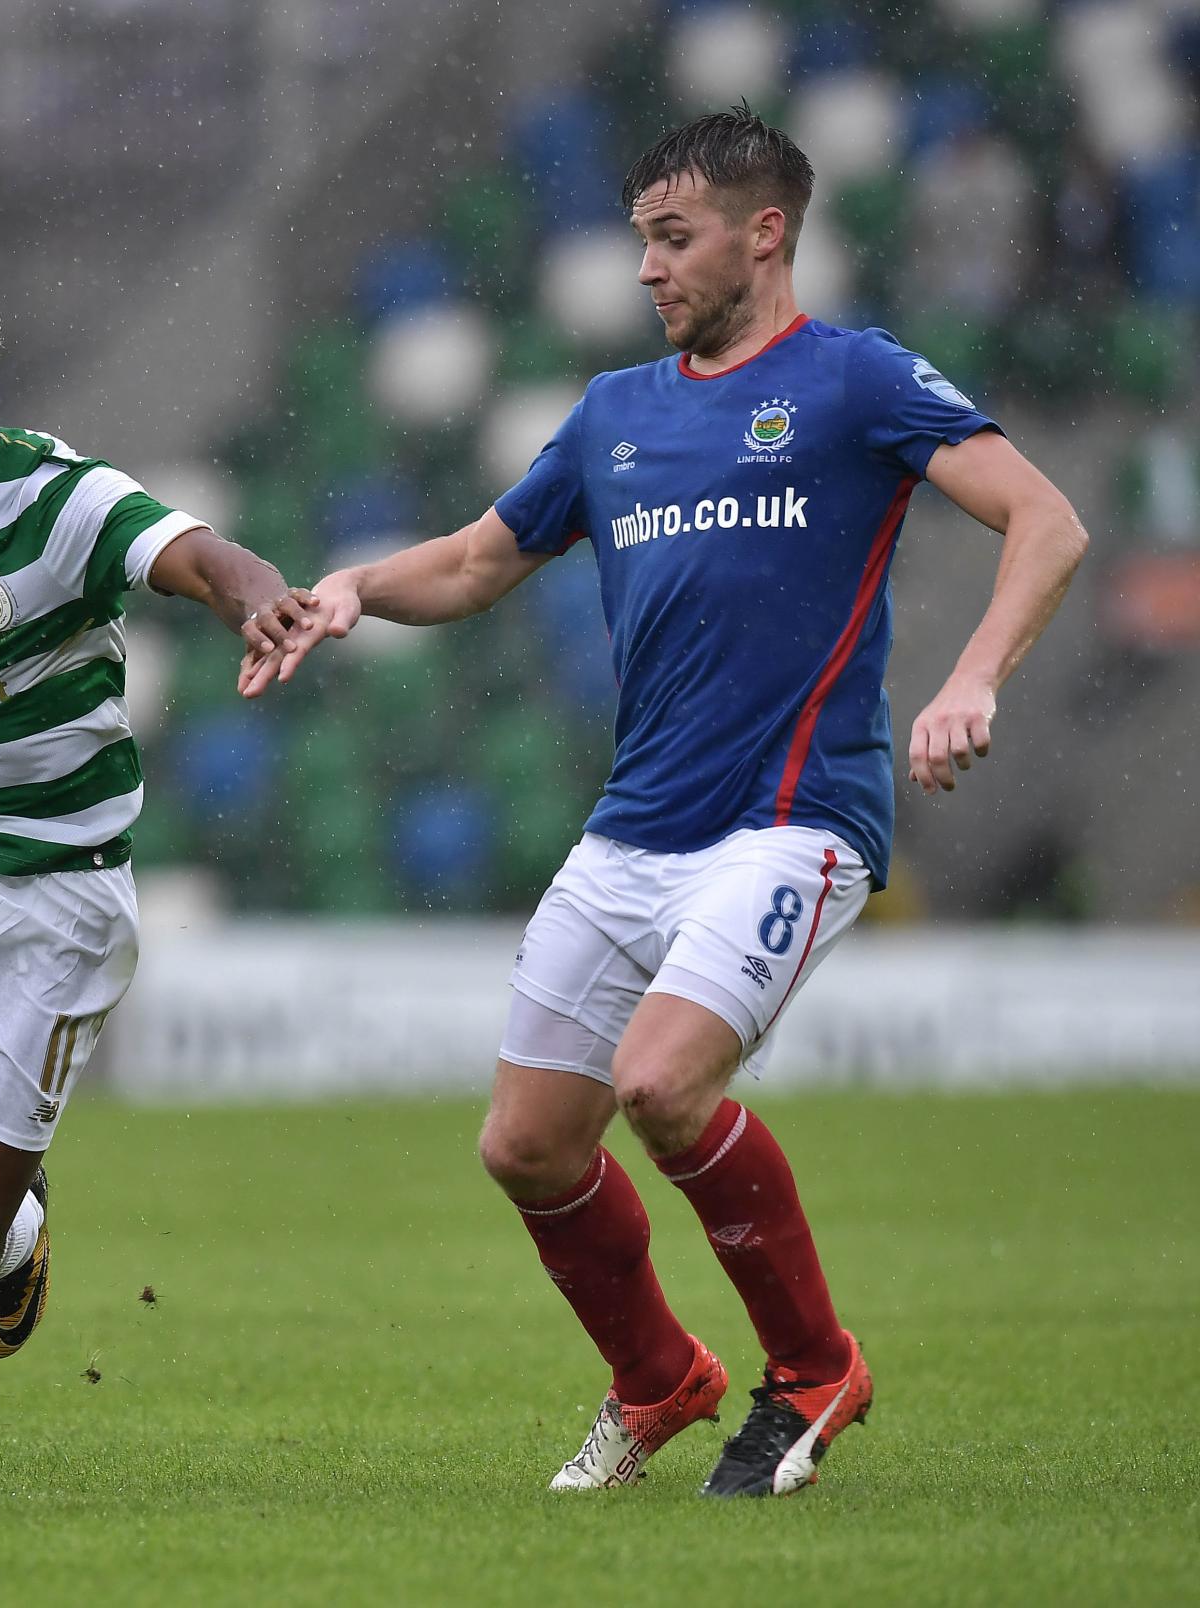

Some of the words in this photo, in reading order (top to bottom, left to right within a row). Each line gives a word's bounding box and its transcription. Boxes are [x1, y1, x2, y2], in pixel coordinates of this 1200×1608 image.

[612, 461, 636, 473] umbro
[736, 455, 777, 464] LINFIELD
[779, 455, 793, 464] FC
[611, 486, 809, 550] umbro.co.uk
[757, 885, 804, 956] 8
[741, 965, 766, 990] umbro
[38, 1012, 78, 1096] 11
